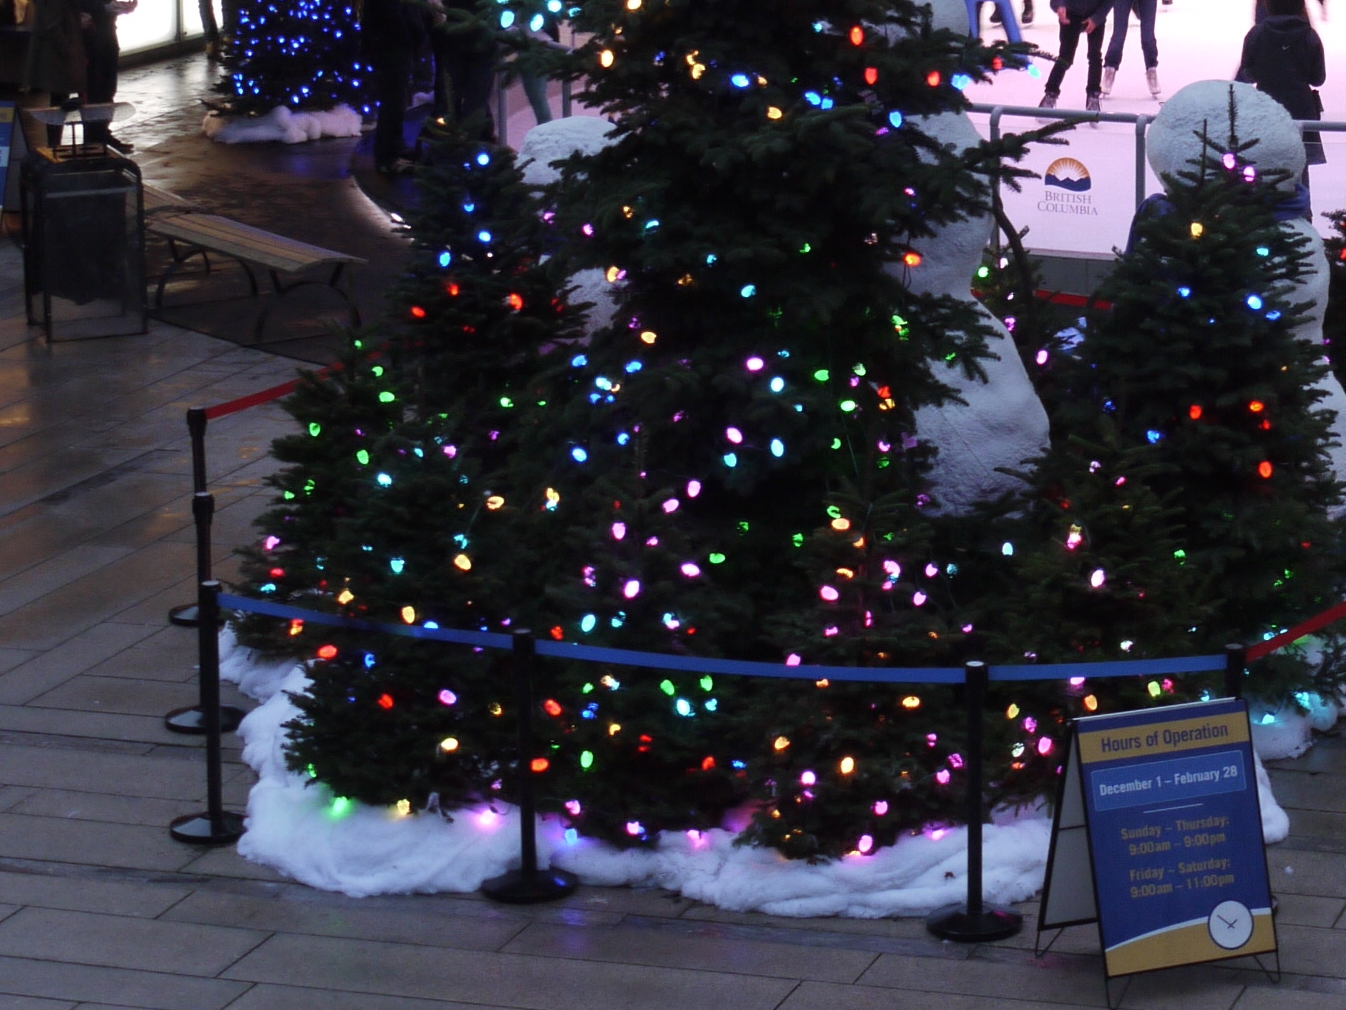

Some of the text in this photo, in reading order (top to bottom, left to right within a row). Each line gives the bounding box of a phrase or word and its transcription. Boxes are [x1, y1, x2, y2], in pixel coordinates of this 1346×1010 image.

[1037, 201, 1098, 216] COLUMBIA
[1045, 191, 1092, 204] BRITISH
[1101, 723, 1229, 752] Hours of Operation
[1100, 778, 1152, 796] December
[1155, 775, 1162, 788] 1
[1174, 768, 1220, 785] February
[1222, 765, 1238, 778] 28
[1120, 824, 1162, 840] Sunday
[1175, 815, 1230, 832] Thursday:
[1128, 840, 1171, 856] 9:00am
[1184, 832, 1226, 848] 9:00pm
[1130, 866, 1164, 882] Friday
[1178, 858, 1231, 874] Saturday:
[1130, 883, 1173, 898] 9:00am
[1187, 873, 1235, 890] 11:00pm
